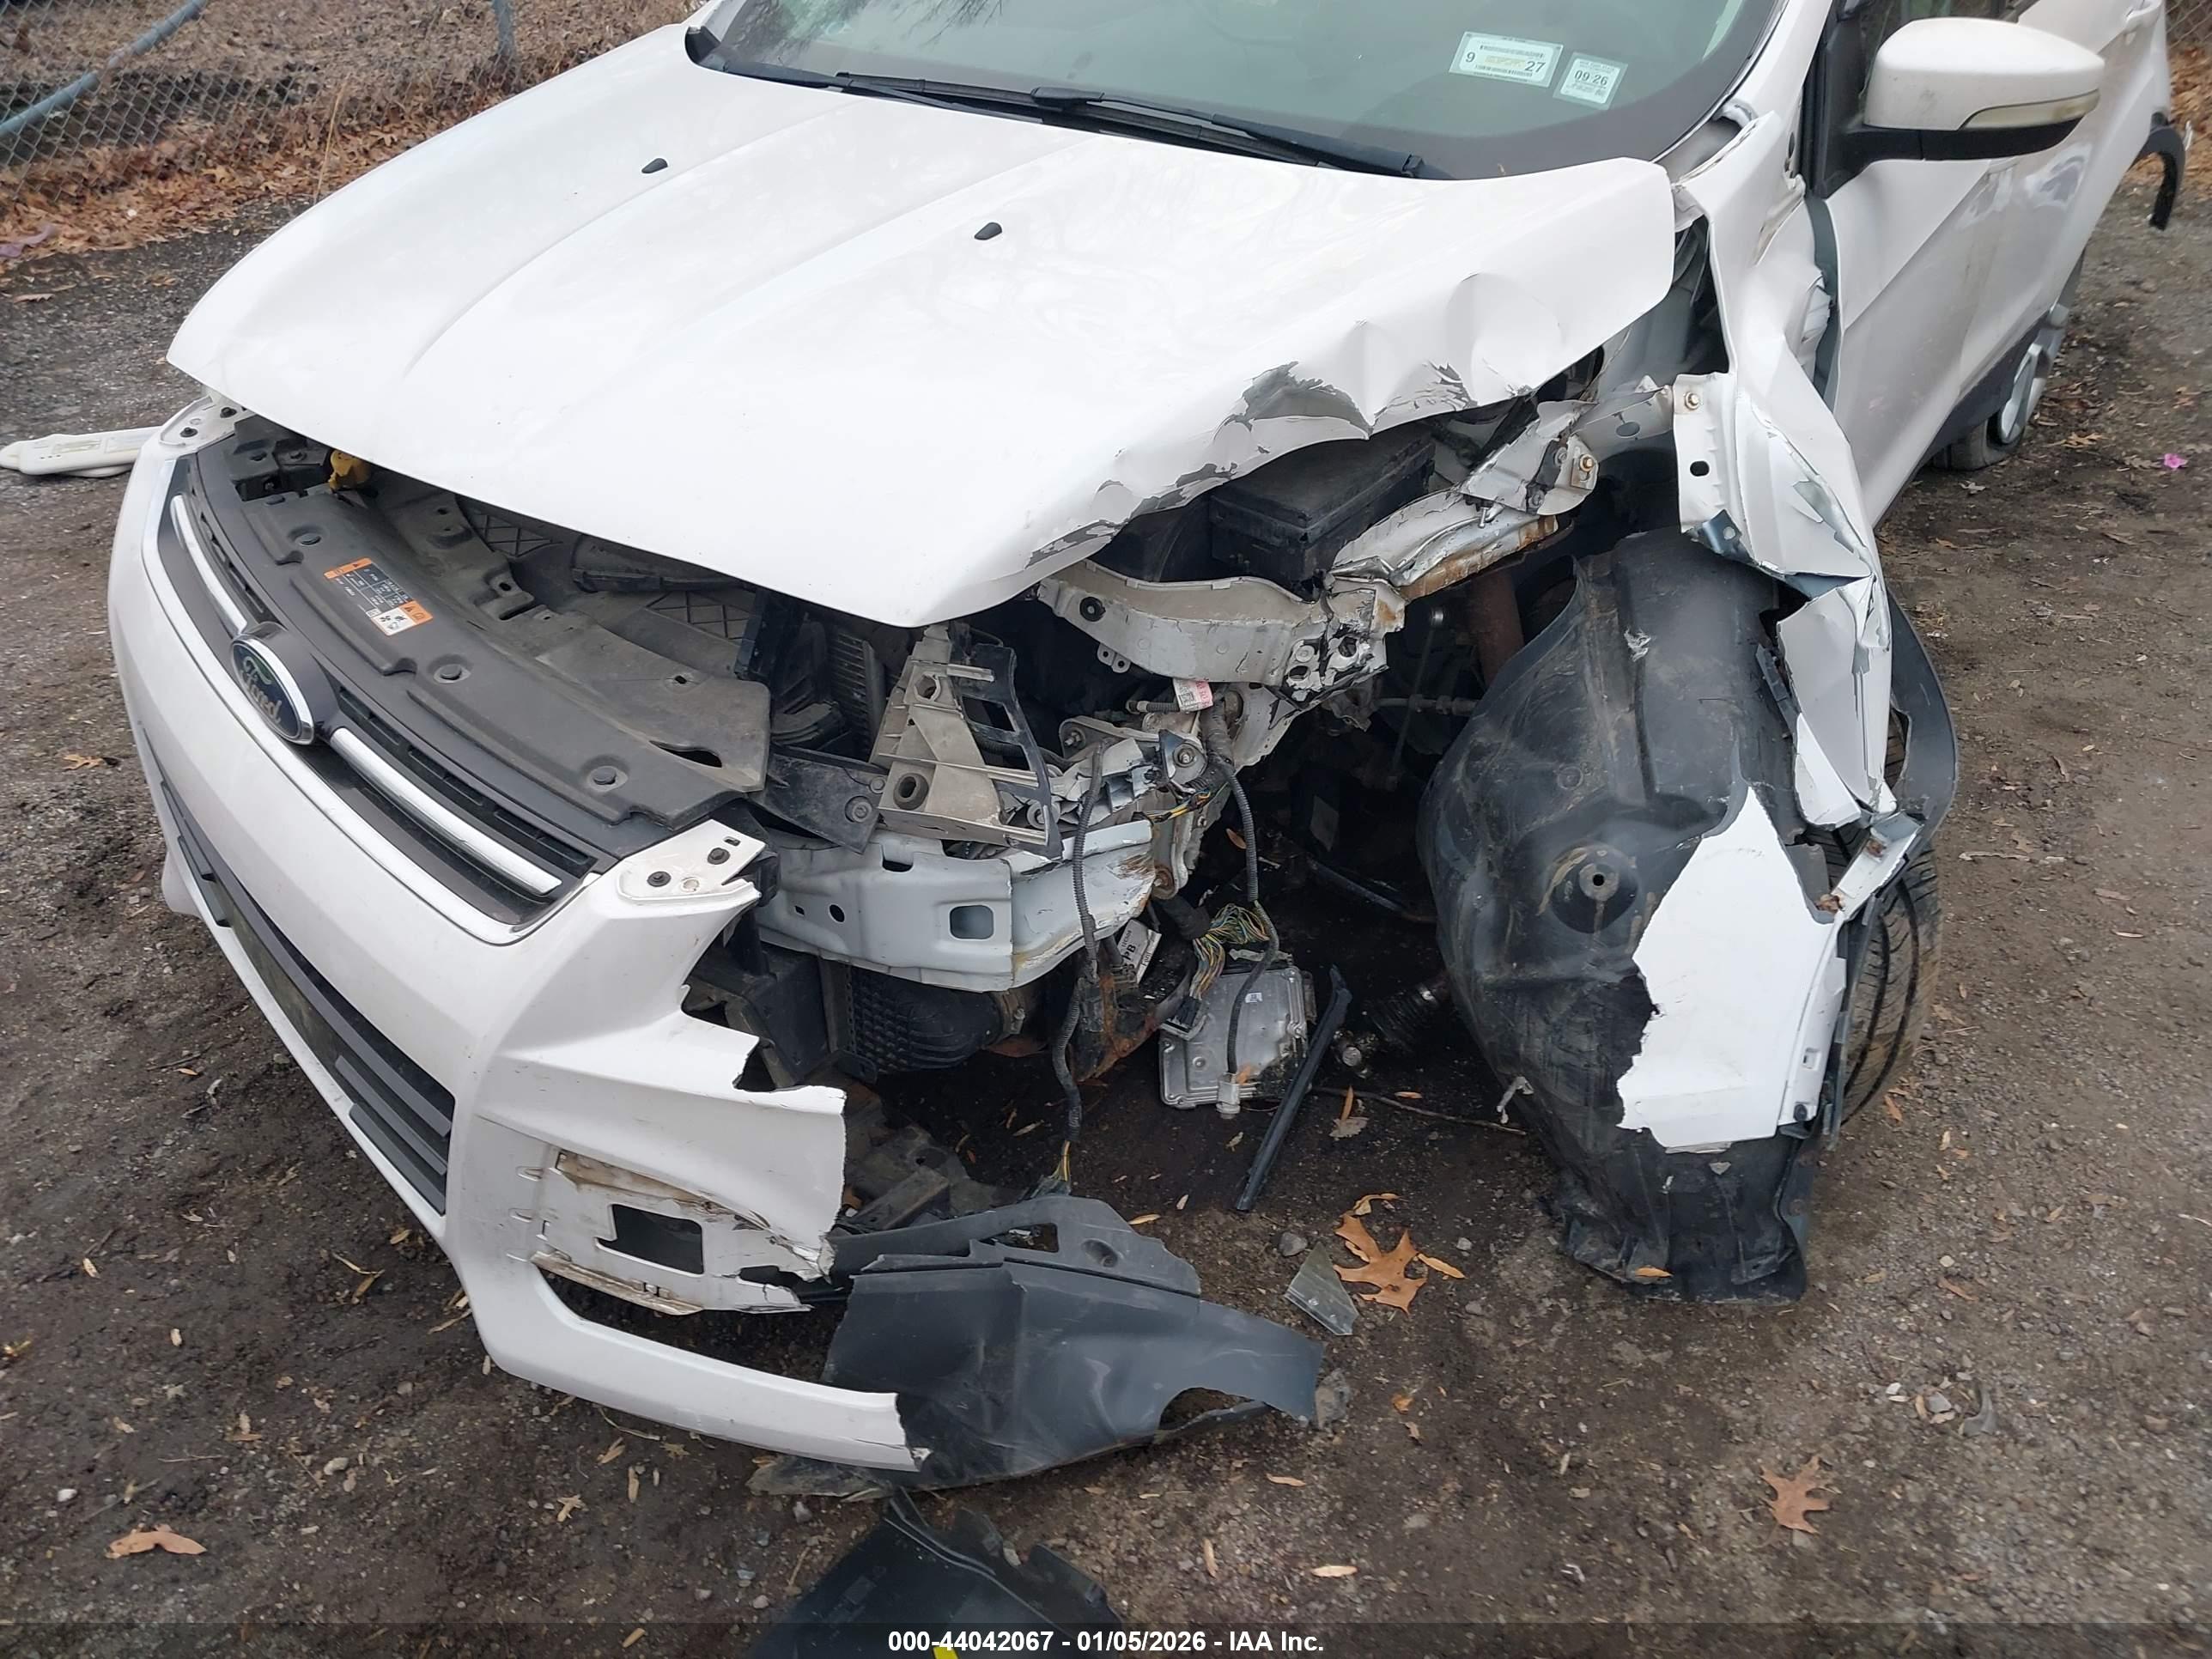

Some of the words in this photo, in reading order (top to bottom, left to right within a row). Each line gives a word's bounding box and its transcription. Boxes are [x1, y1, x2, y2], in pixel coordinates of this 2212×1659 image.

[1465, 52, 1475, 63] 9
[1525, 60, 1546, 73] 27
[241, 656, 282, 724] Ford
